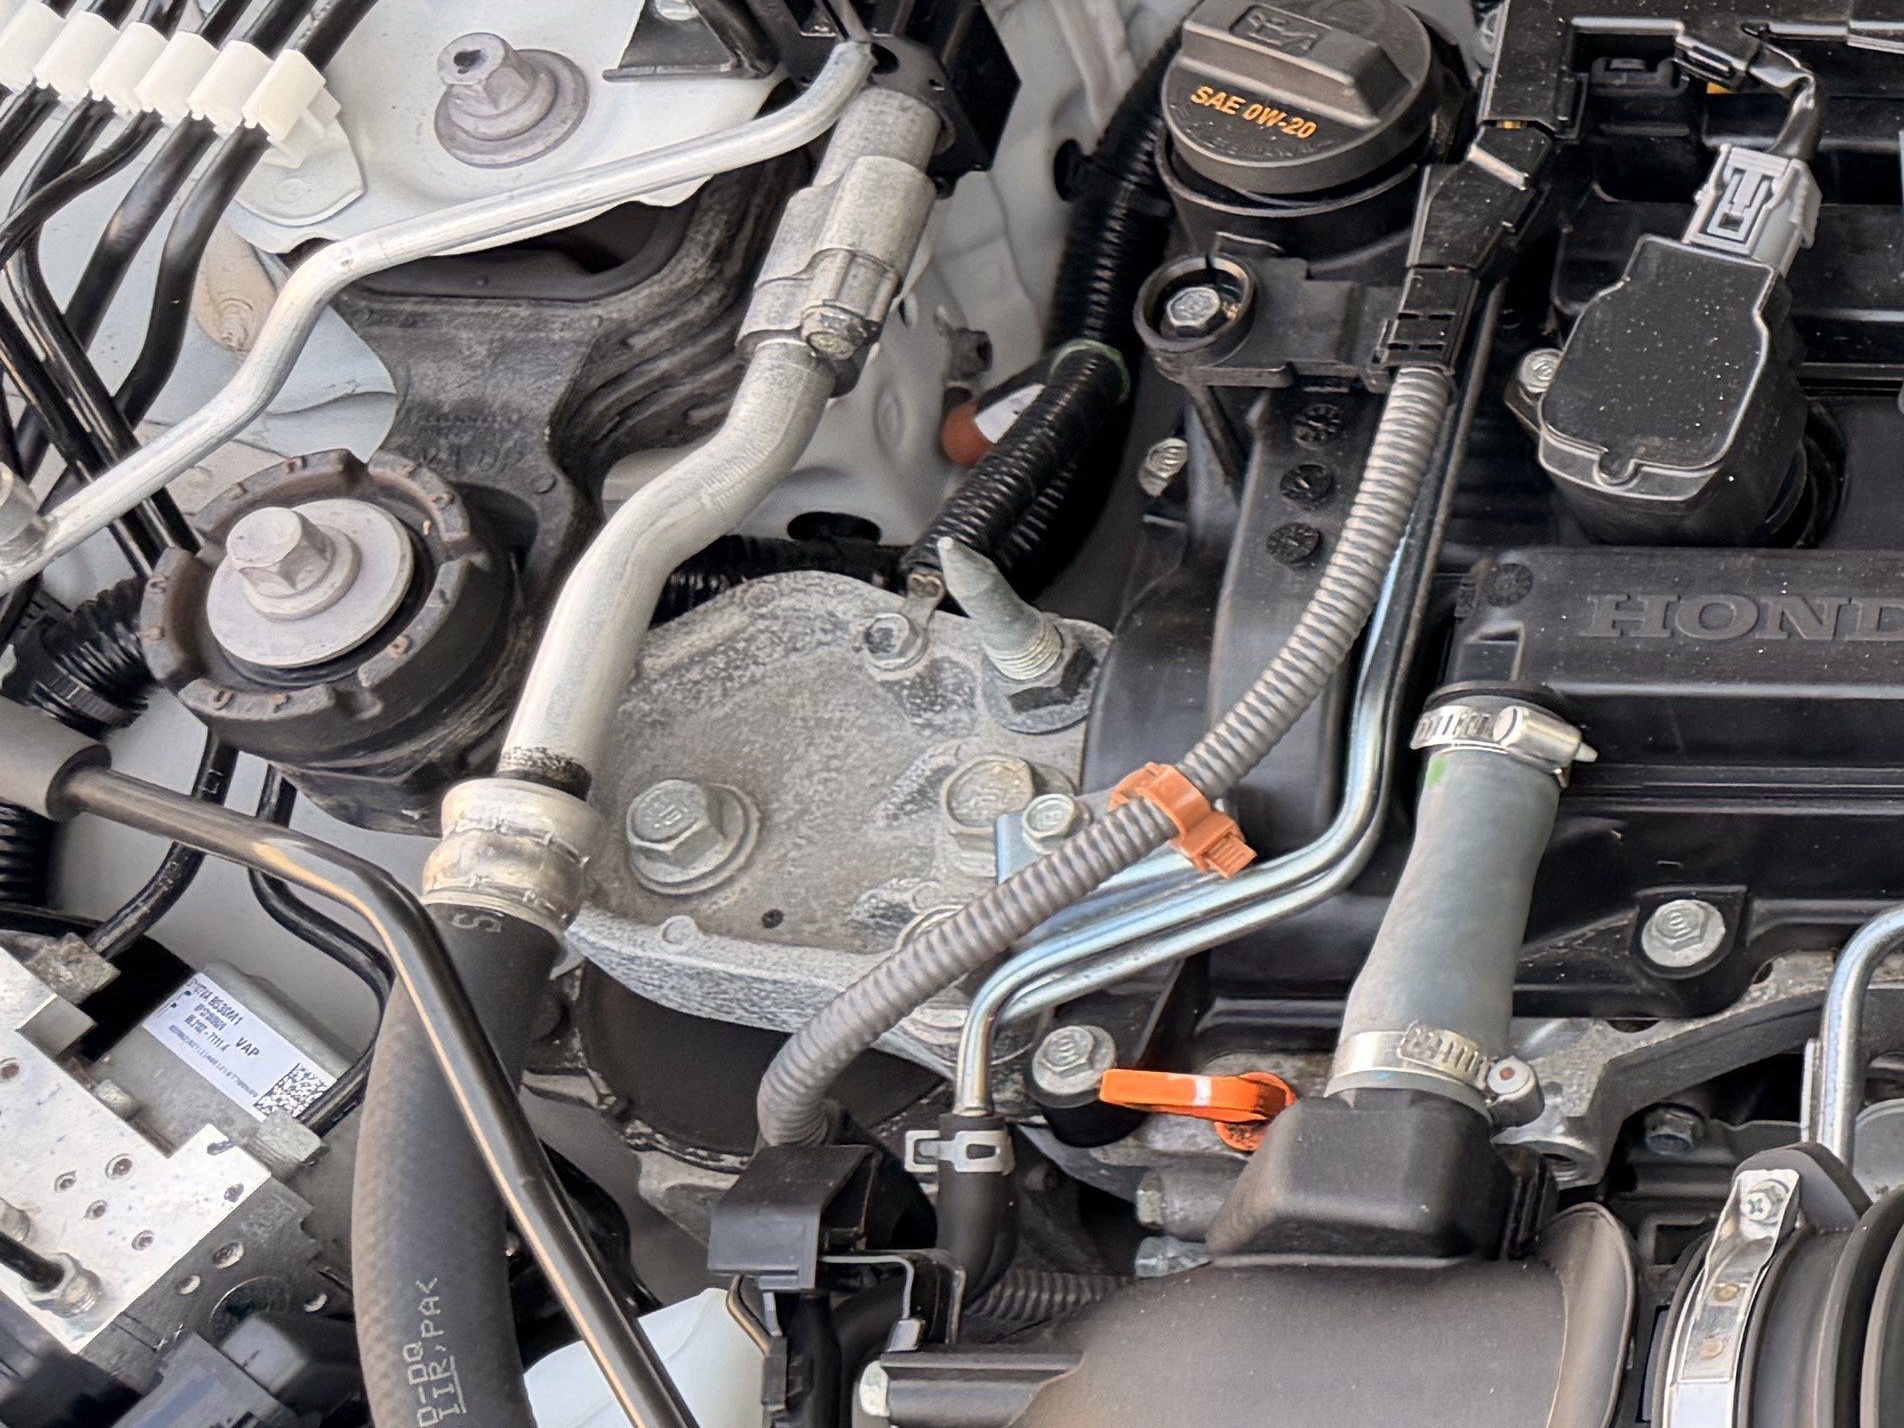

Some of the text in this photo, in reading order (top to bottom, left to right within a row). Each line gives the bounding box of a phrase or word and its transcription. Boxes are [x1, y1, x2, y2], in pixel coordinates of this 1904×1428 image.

[1190, 85, 1317, 139] SAE 0W-20
[234, 1037, 261, 1058] VAP
